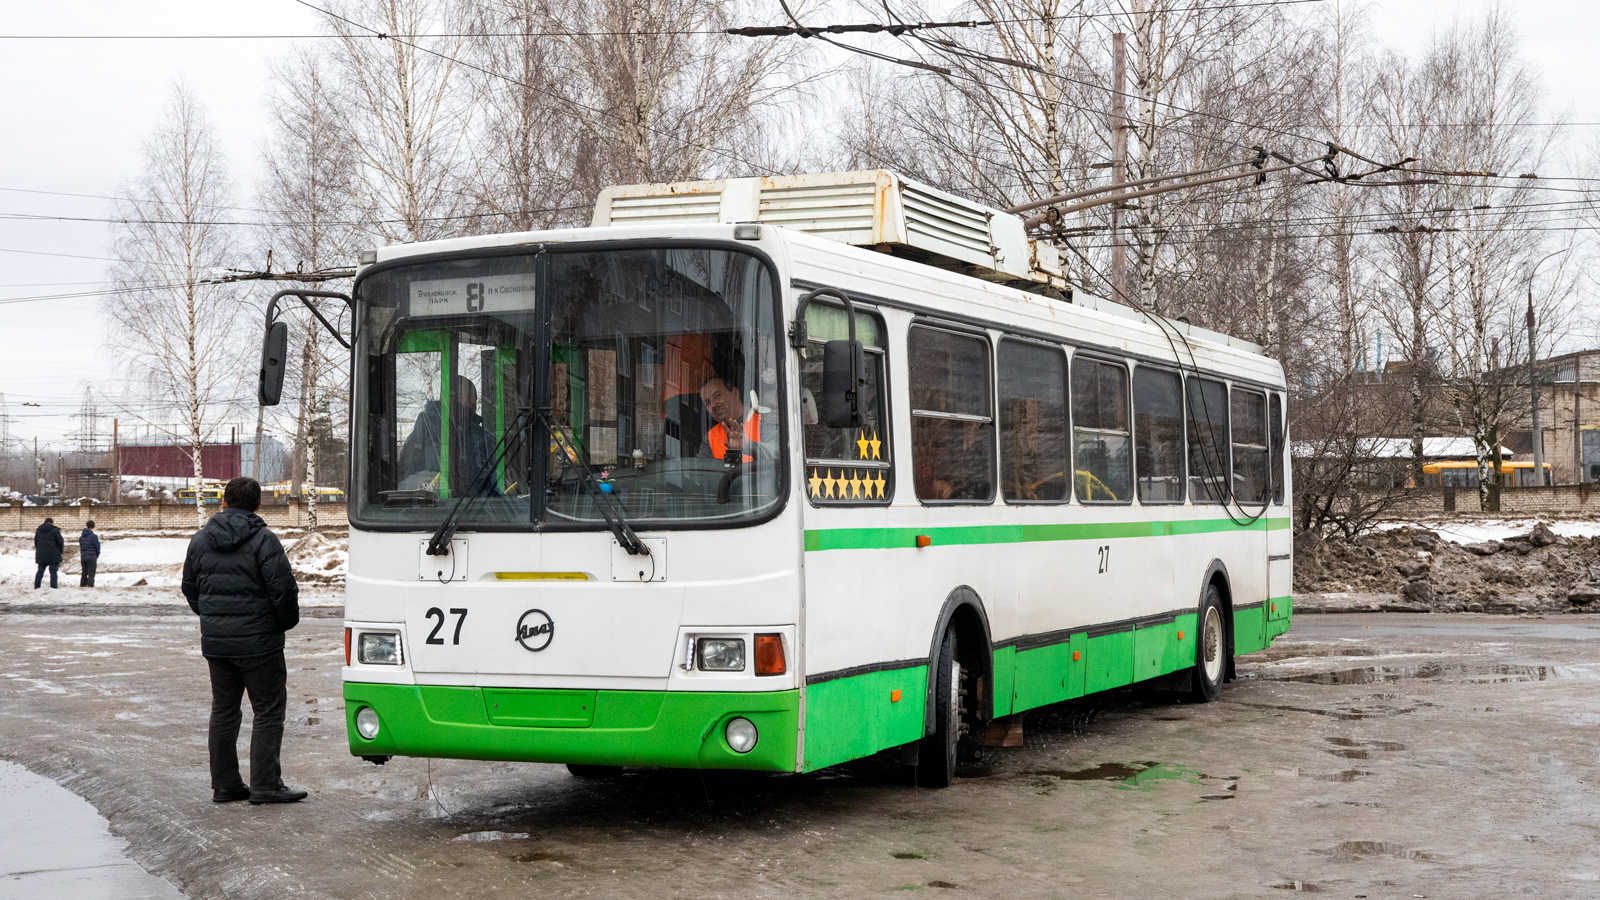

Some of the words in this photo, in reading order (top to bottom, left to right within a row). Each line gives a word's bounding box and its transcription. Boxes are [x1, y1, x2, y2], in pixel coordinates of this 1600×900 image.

[466, 282, 485, 312] 8
[1098, 545, 1110, 574] 27
[425, 607, 468, 645] 27
